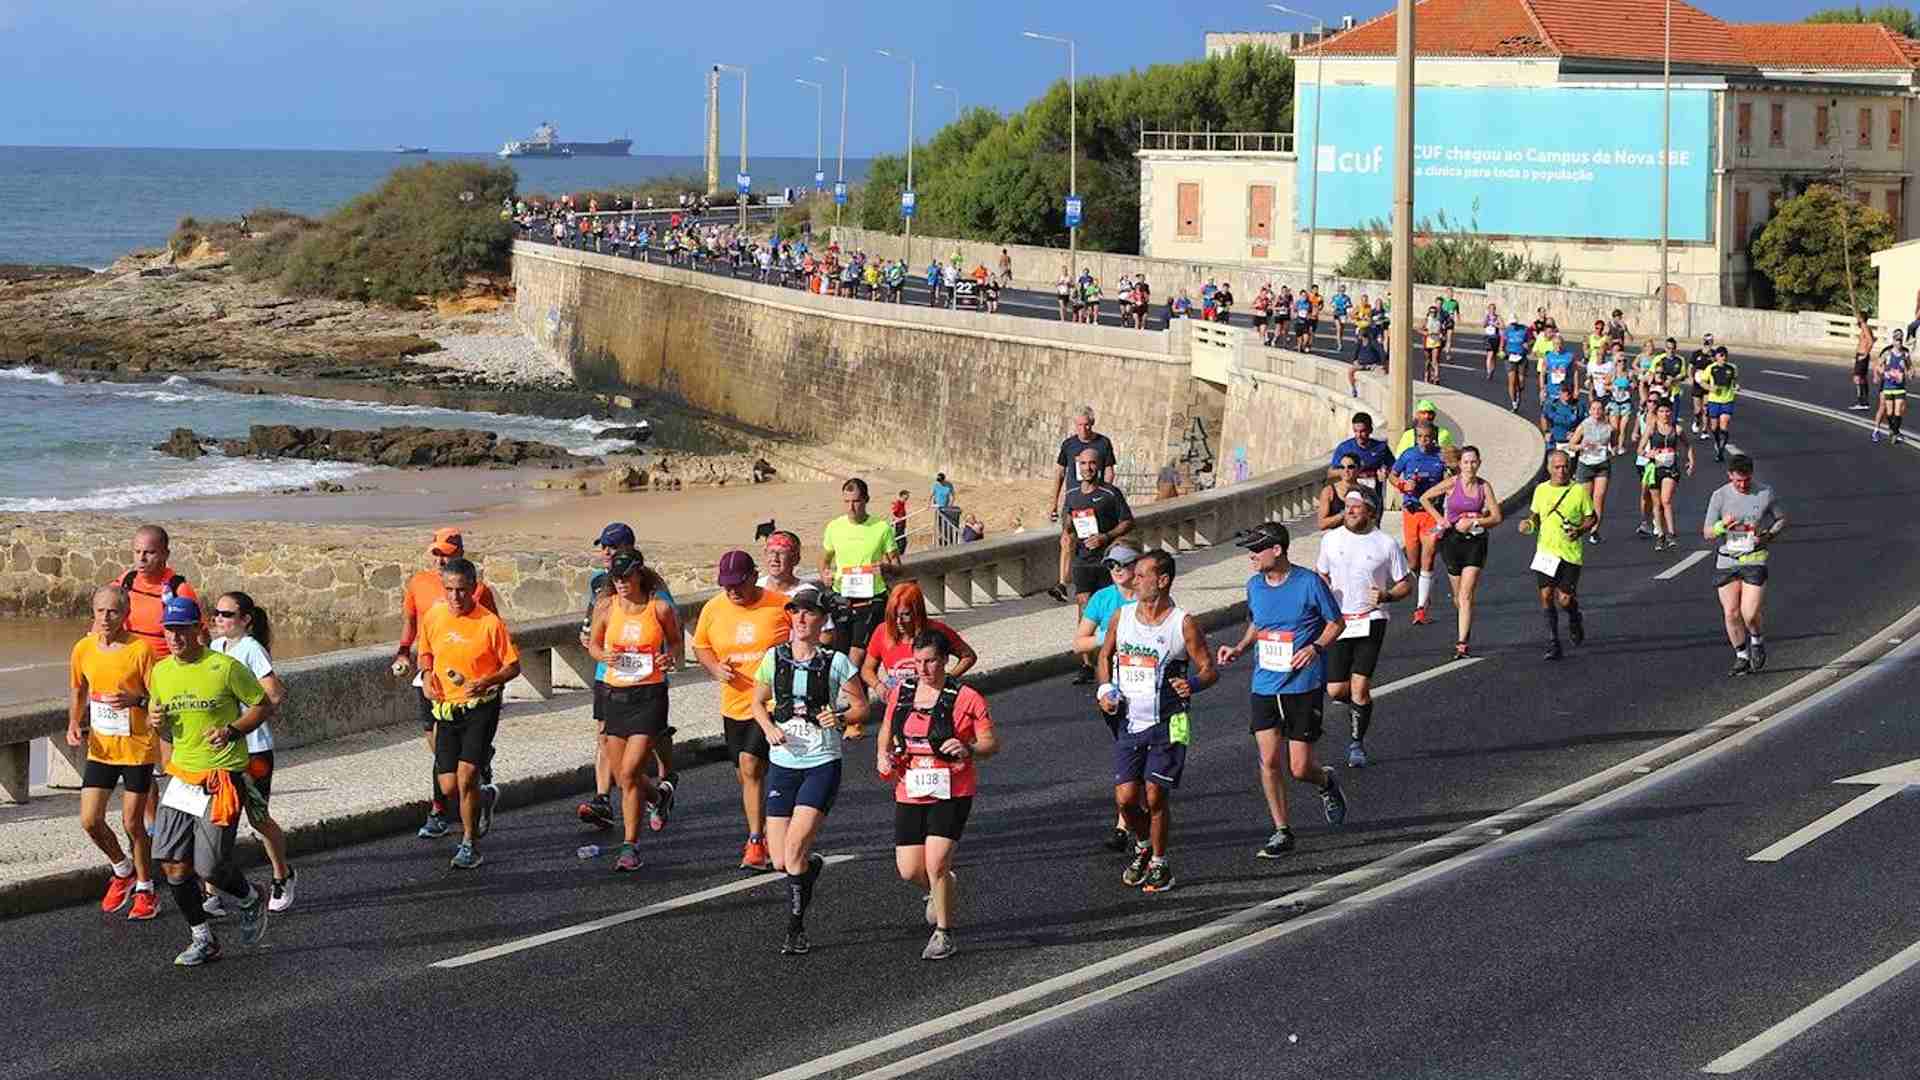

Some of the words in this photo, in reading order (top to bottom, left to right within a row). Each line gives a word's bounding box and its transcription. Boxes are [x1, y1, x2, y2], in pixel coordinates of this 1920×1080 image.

[1338, 145, 1383, 174] cuf
[1414, 144, 1443, 159] CUF
[1446, 145, 1501, 163] chegou
[1525, 148, 1591, 166] Campus
[1614, 150, 1656, 166] Nova
[1464, 168, 1491, 180] para
